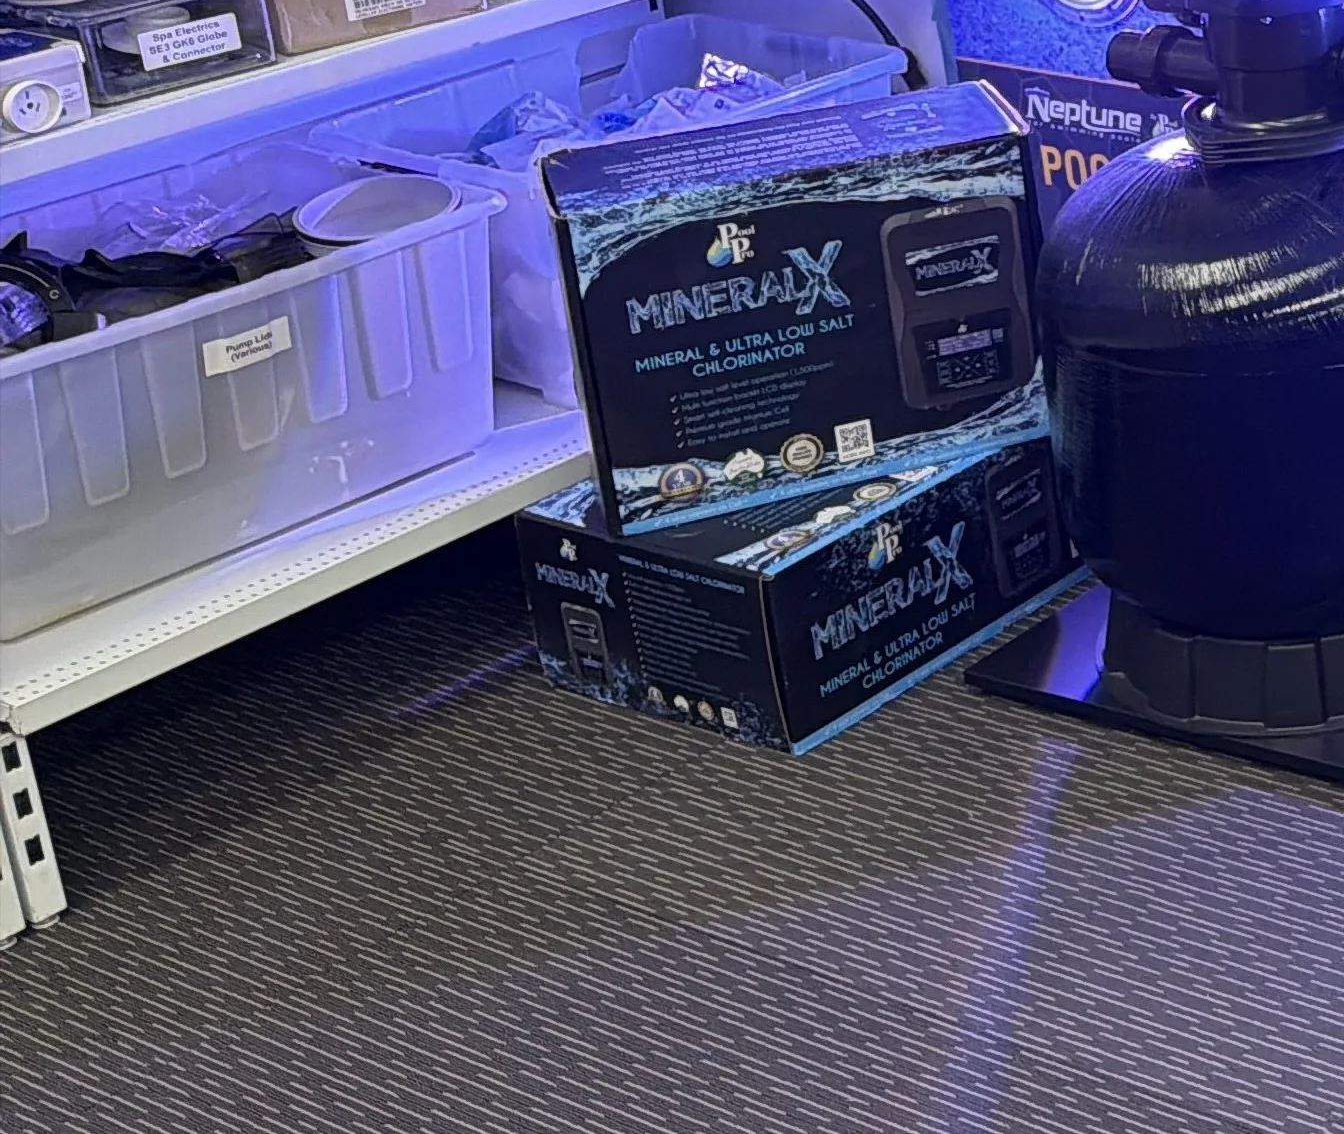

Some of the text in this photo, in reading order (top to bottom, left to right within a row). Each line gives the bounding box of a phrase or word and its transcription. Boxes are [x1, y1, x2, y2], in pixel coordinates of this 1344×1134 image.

[148, 29, 228, 55] SE3 GK6 Globe
[152, 20, 220, 43] Spa Electrics
[162, 42, 227, 64] & Connector
[1025, 94, 1142, 137] Neptune
[717, 222, 756, 249] Pool
[731, 238, 755, 265] Pro
[625, 239, 851, 335] MINERALX
[225, 338, 254, 354] Pump
[230, 340, 273, 364] (Various)
[635, 314, 855, 373] MINERAL & ULTRA LOW SALT
[692, 342, 806, 378] CHLORINATOR
[673, 469, 686, 484] 4
[810, 520, 974, 661] MINERALX
[819, 592, 977, 698] MINERAL & ULTRA LOW SALT
[861, 632, 944, 689] CHLORINATOR
